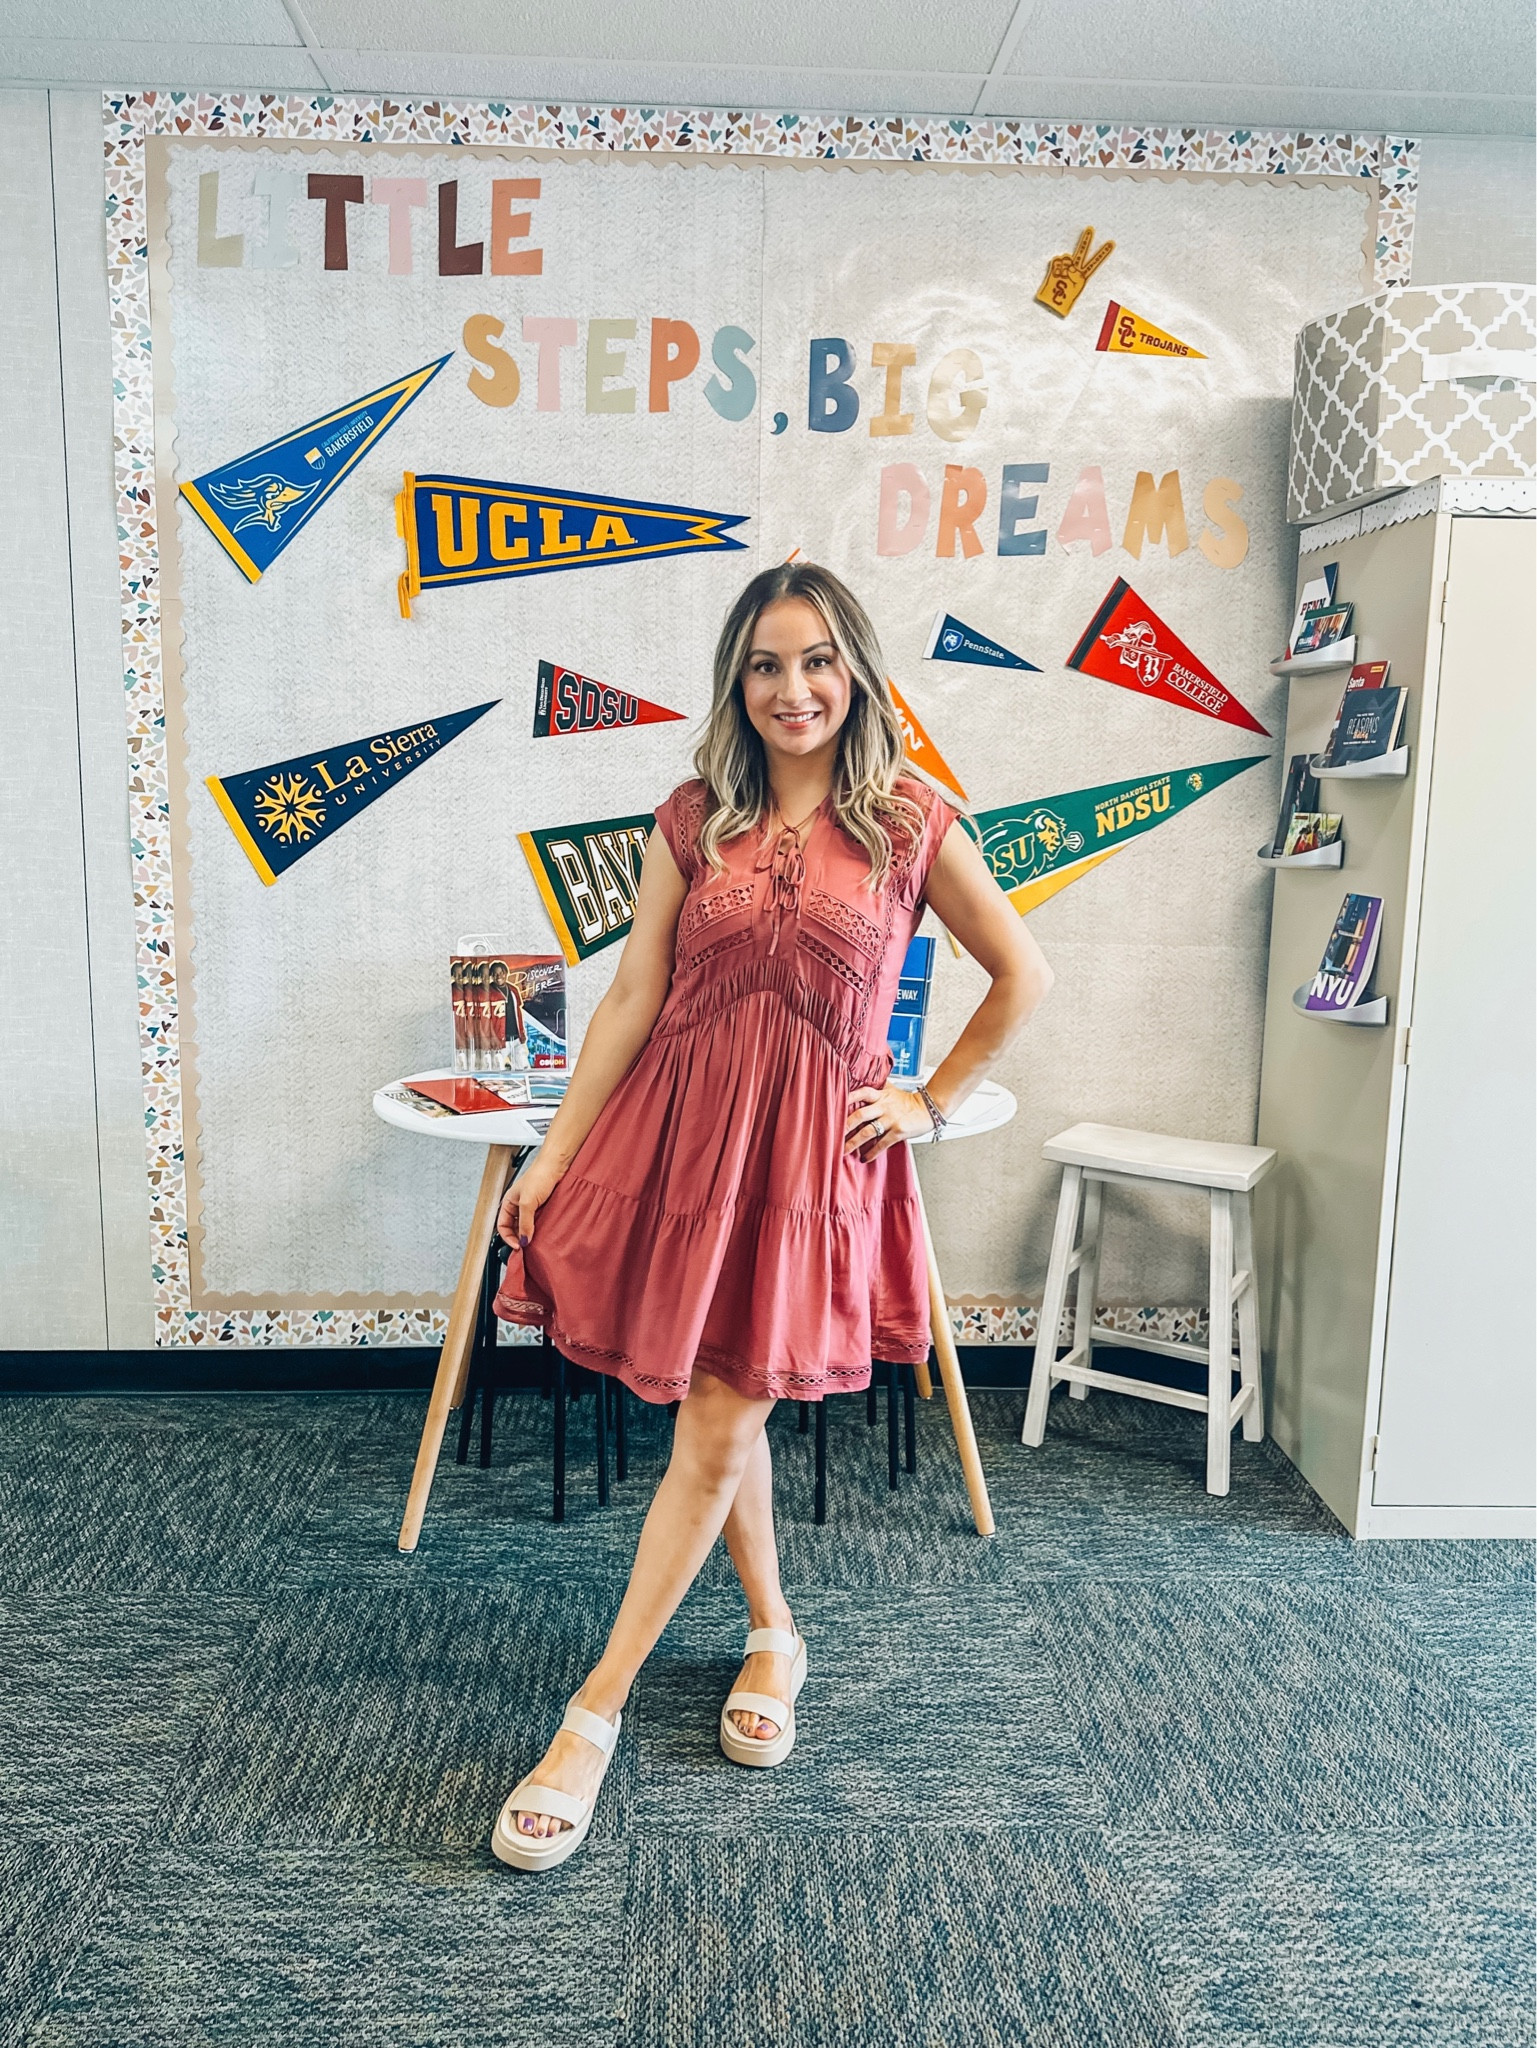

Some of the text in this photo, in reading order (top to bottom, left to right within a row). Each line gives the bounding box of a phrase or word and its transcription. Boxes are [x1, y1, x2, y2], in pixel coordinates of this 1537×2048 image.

[197, 170, 543, 276] LITTLE
[1139, 332, 1189, 356] TROJANS
[808, 337, 989, 442] BIG
[324, 416, 374, 457] BAKERSFIELD
[431, 493, 636, 568] UCLA
[876, 461, 1249, 570] DREAMS
[1300, 598, 1326, 615] PENN
[554, 670, 639, 733] SDSU
[1166, 671, 1224, 714] COLLEGE
[1172, 662, 1229, 703] BAKERSFIELD
[1346, 716, 1380, 734] REASONS
[311, 723, 438, 794] La Sierra
[335, 738, 442, 806] UNIVERSITY
[1094, 775, 1171, 813] NORTH DAKOTA STATE
[1095, 784, 1172, 838] NDSU
[545, 827, 649, 946] BAY
[507, 964, 562, 985] DISCOVER
[896, 988, 918, 1001] EWAY
[1309, 970, 1355, 1006] NYU
[539, 1058, 564, 1066] CSUDH
